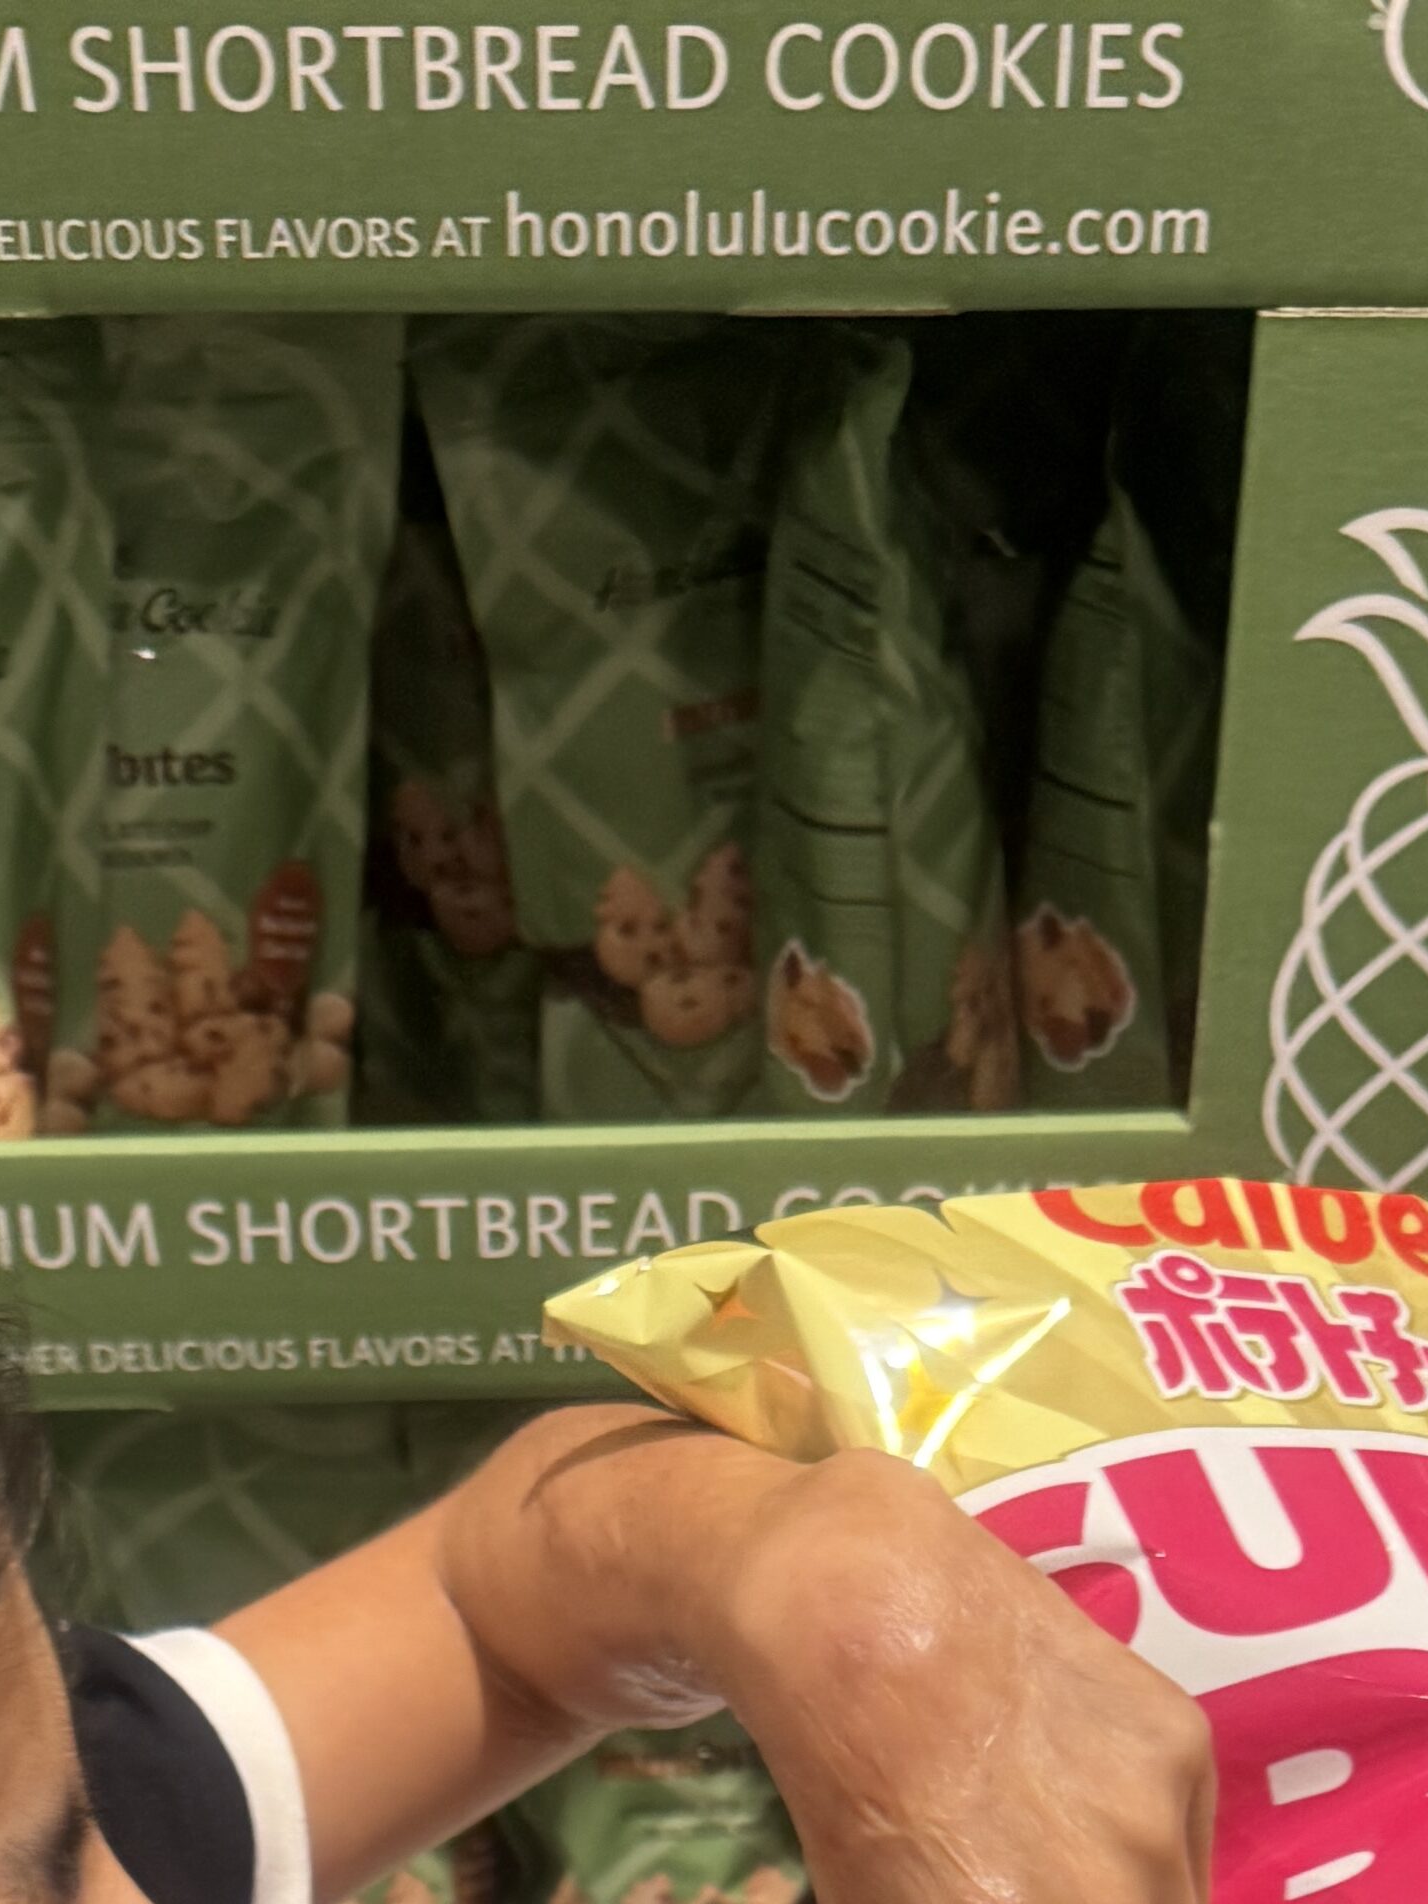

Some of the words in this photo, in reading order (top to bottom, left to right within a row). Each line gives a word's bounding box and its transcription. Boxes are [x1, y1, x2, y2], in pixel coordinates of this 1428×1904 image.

[70, 24, 729, 113] SHORTBREAD
[765, 22, 1184, 110] COOKIES
[216, 216, 419, 259] FLAVORS
[431, 216, 492, 258] AT
[507, 189, 1210, 258] honolulucookie.com
[185, 1190, 745, 1268] SHORTBREAD
[89, 1338, 297, 1375] DELICIOUS
[308, 1334, 480, 1370] FLAVORS
[489, 1334, 542, 1365] AT
